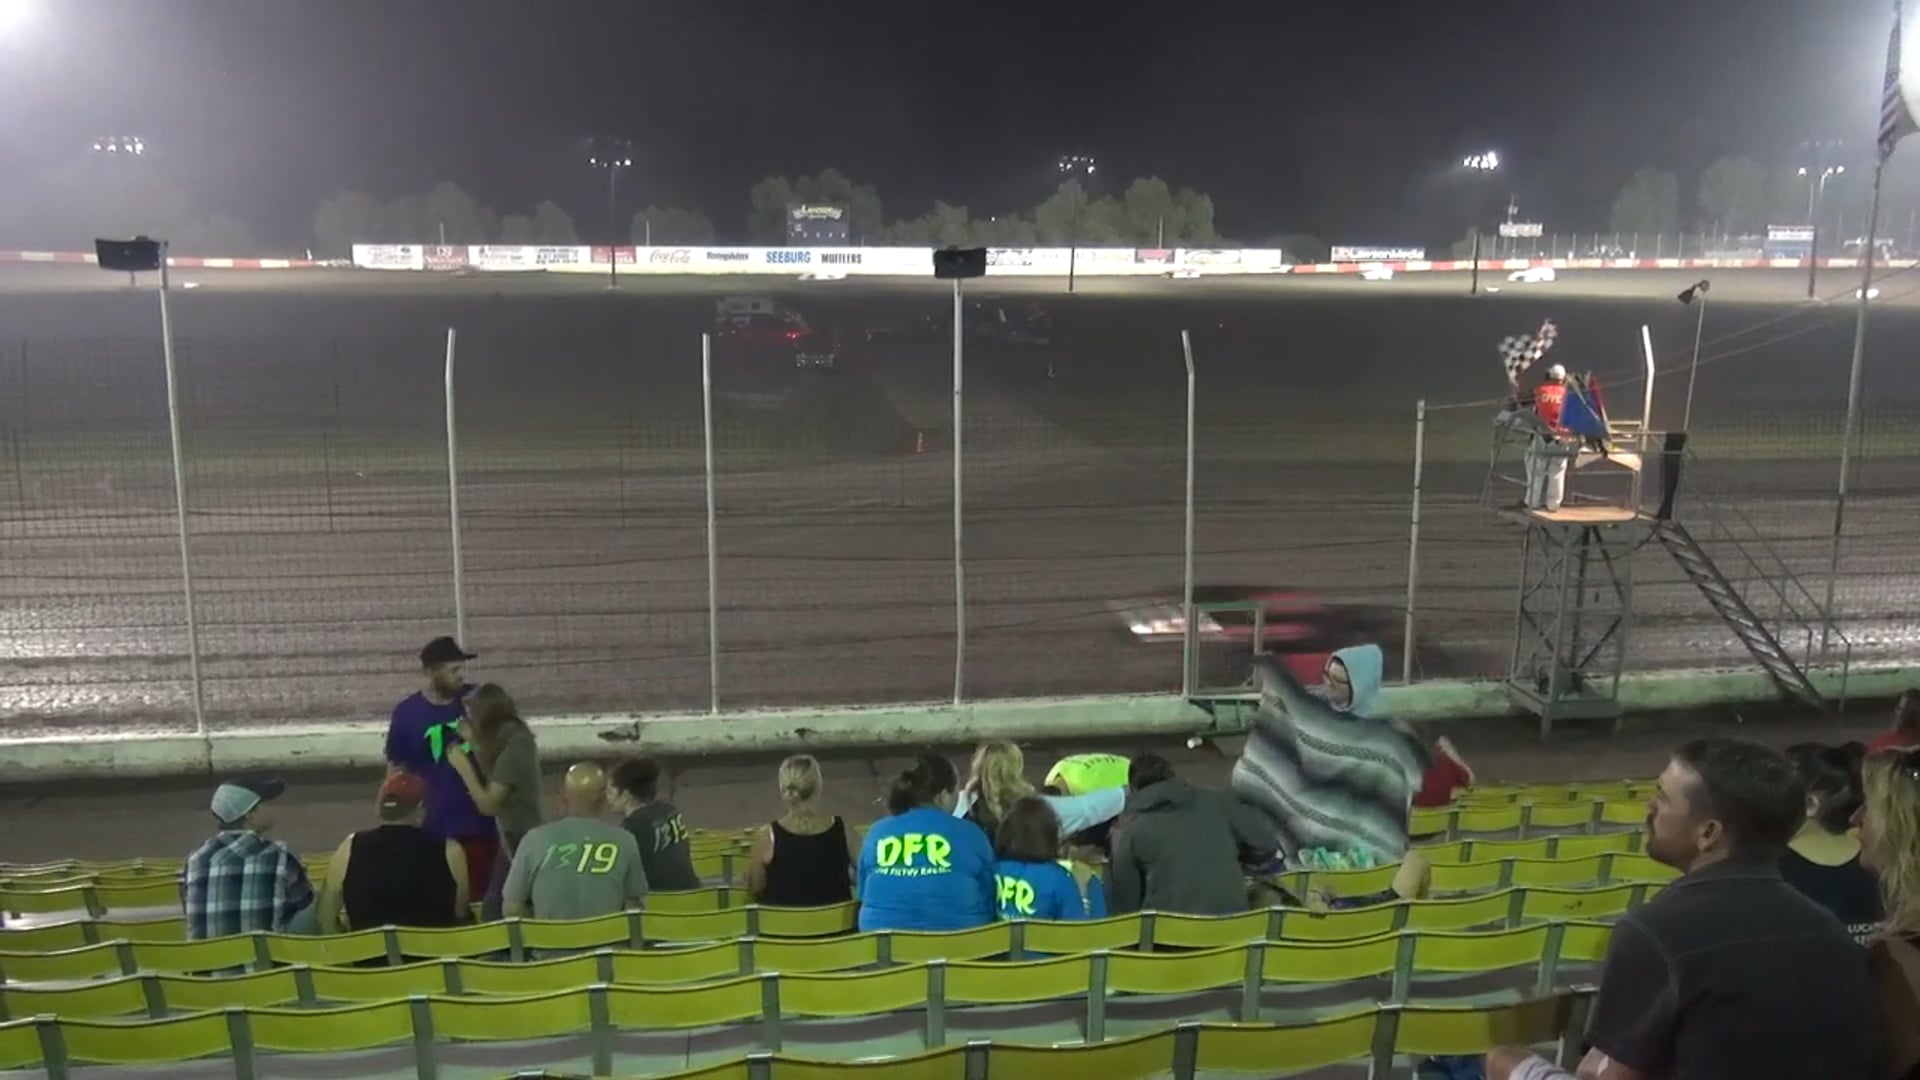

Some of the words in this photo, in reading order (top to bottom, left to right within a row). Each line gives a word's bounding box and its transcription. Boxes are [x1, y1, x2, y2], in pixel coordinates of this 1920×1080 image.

[766, 251, 811, 264] SEEBURG
[821, 253, 862, 264] MUFFLERS
[877, 832, 952, 868] DFR
